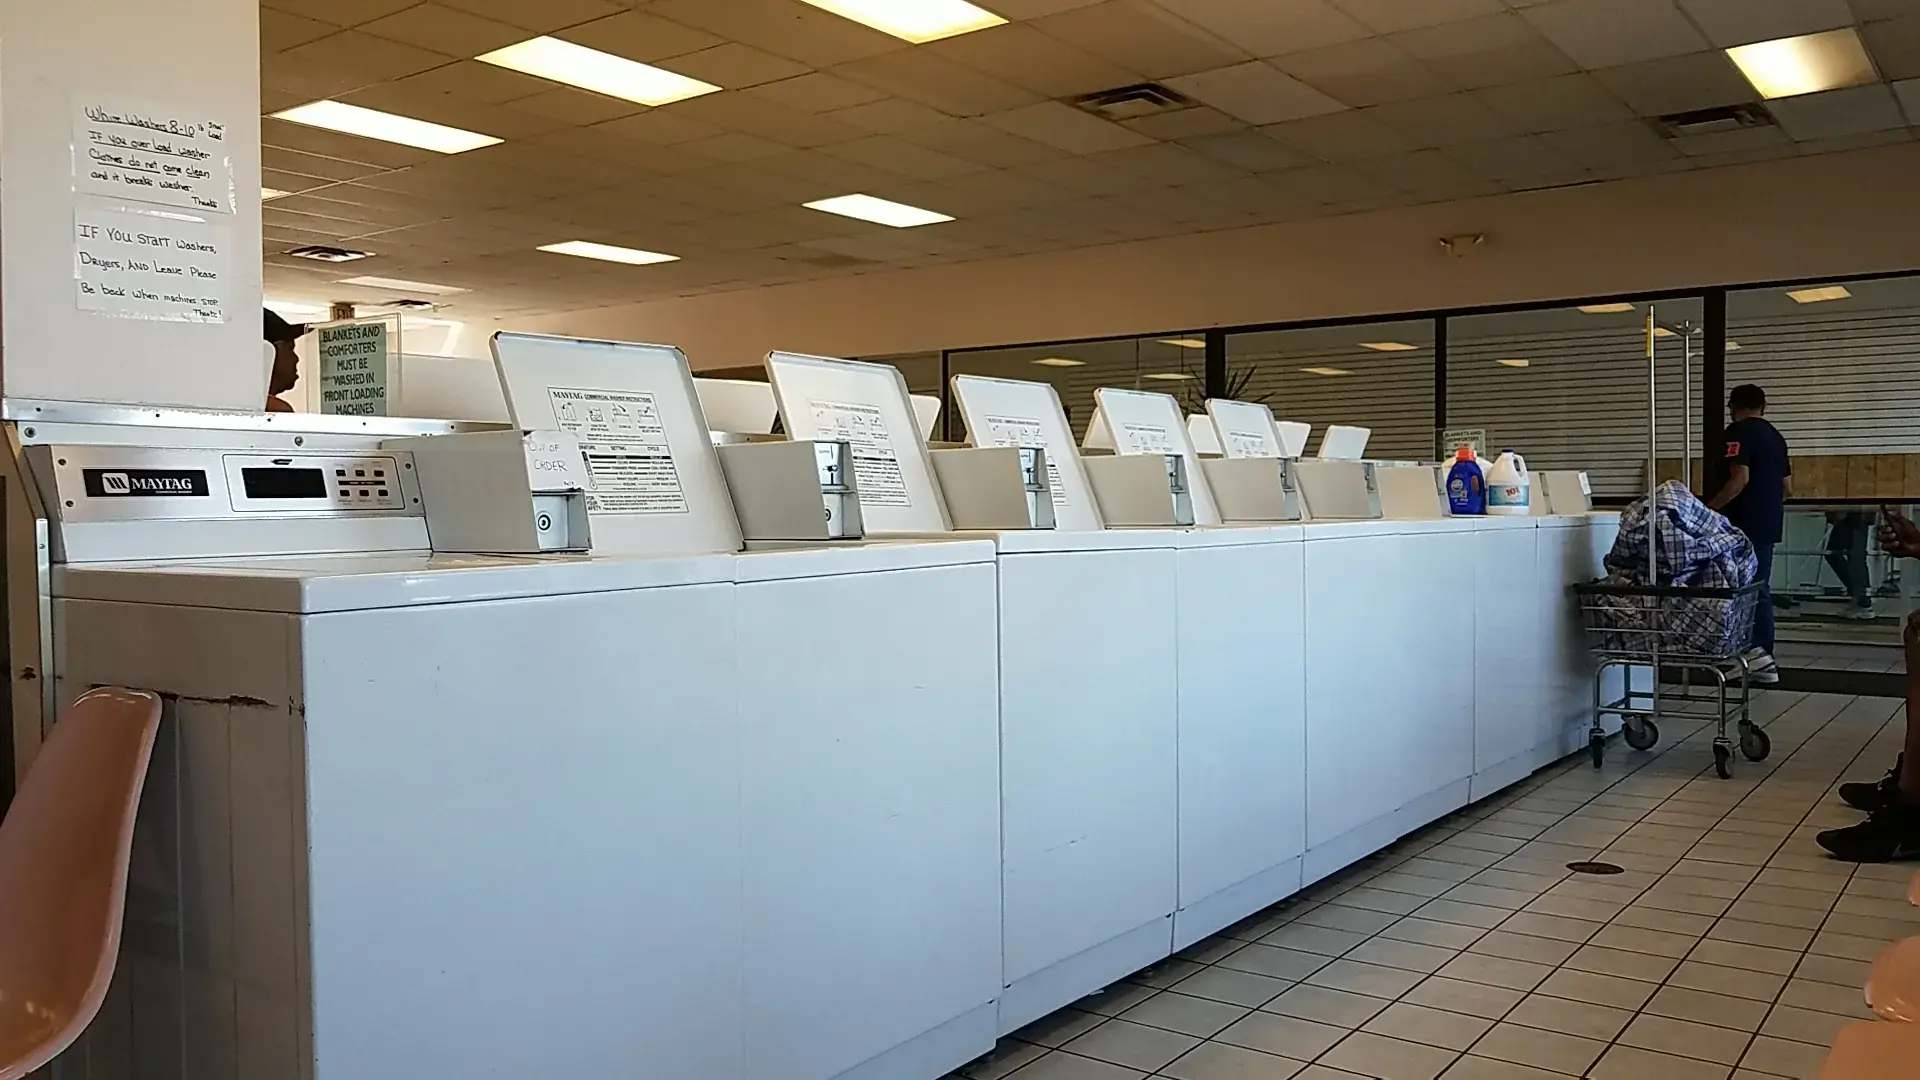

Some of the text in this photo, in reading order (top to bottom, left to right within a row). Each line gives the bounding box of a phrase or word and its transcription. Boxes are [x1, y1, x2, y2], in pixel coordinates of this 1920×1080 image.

[169, 119, 195, 137] 8-10
[88, 147, 124, 165] Clothes
[128, 154, 141, 167] do
[144, 160, 158, 169] not
[185, 164, 210, 179] clean
[90, 170, 108, 181] and
[112, 172, 120, 182] it
[189, 266, 217, 279] Please
[80, 281, 96, 294] Be
[322, 325, 380, 343] BLANKETS AND
[327, 341, 377, 357] COMFORTERS
[336, 357, 369, 371] MUST BE
[333, 371, 375, 386] WASHED IN
[324, 386, 385, 402] FRONT LOADING
[553, 391, 584, 400] MAYTAG
[335, 402, 375, 415] MACHINES
[549, 444, 560, 453] OF
[533, 459, 568, 471] ORDER
[130, 478, 192, 490] MAYTAG
